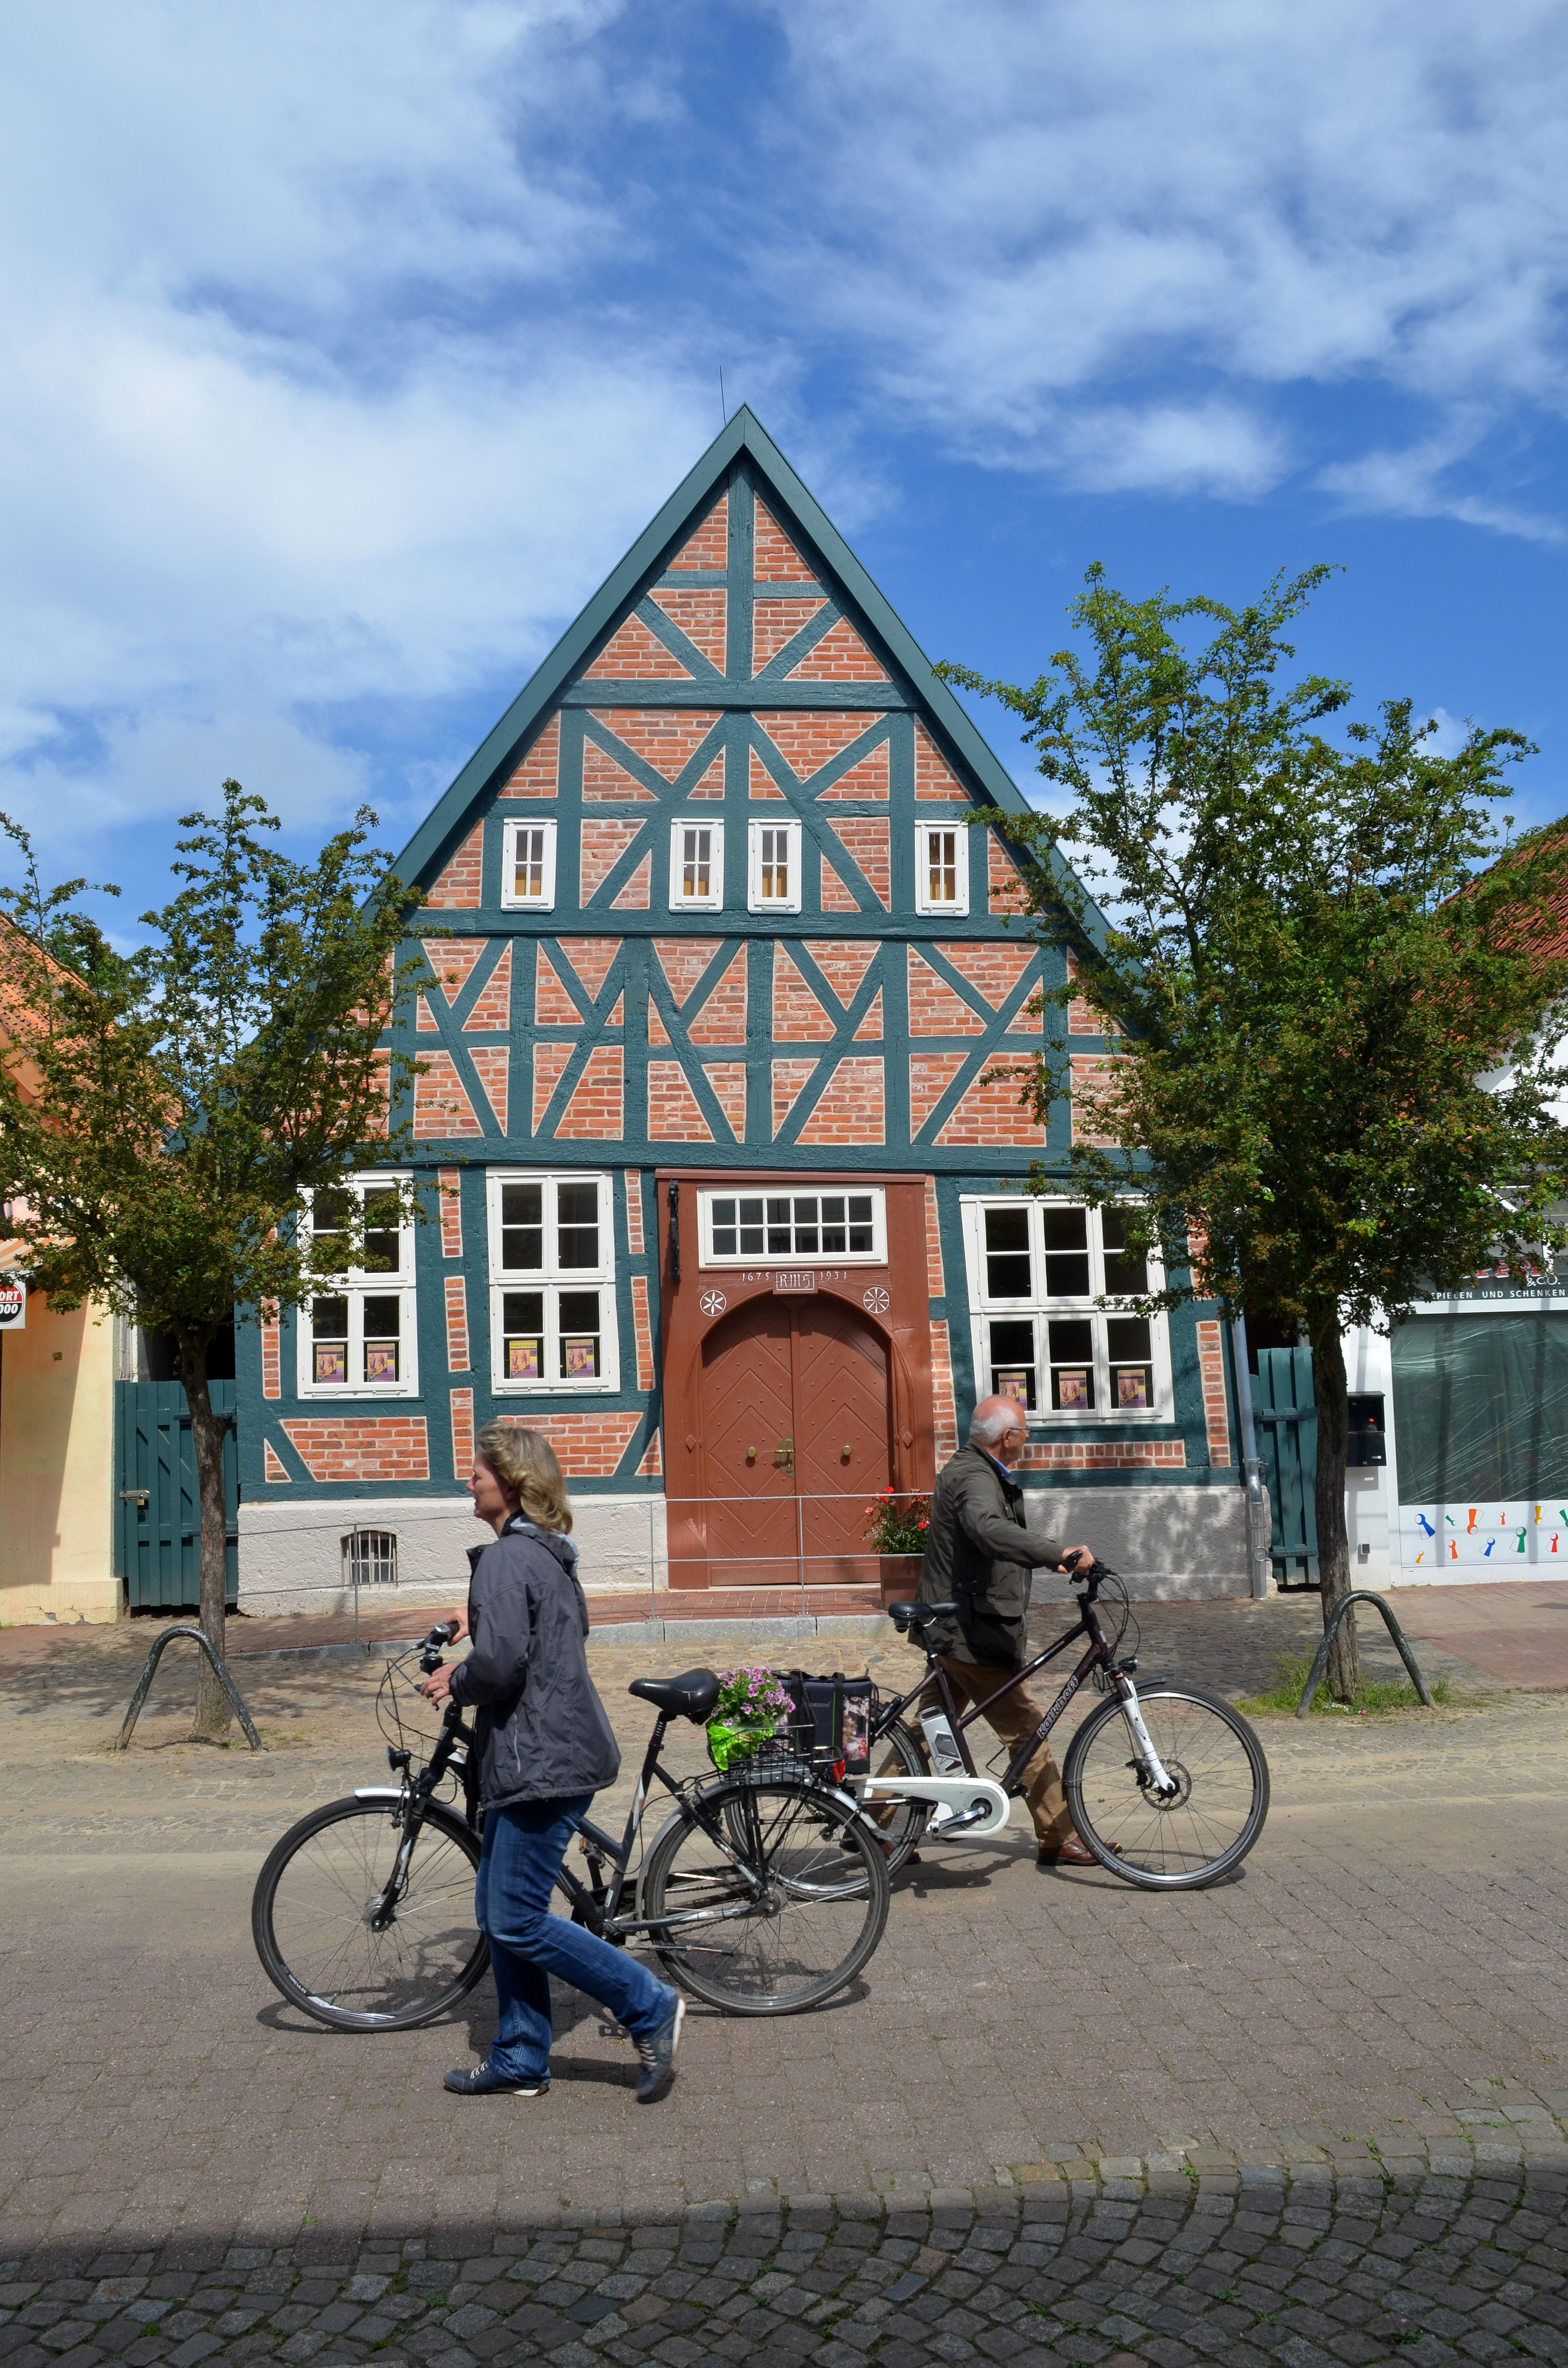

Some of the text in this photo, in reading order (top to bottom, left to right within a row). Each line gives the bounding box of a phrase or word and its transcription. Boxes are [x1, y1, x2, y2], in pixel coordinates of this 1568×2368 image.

[742, 1272, 770, 1282] 1675
[821, 1271, 847, 1280] 1931
[1510, 1289, 1565, 1297] SCHENKEN
[1037, 1675, 1078, 1739] Kalkhoff
